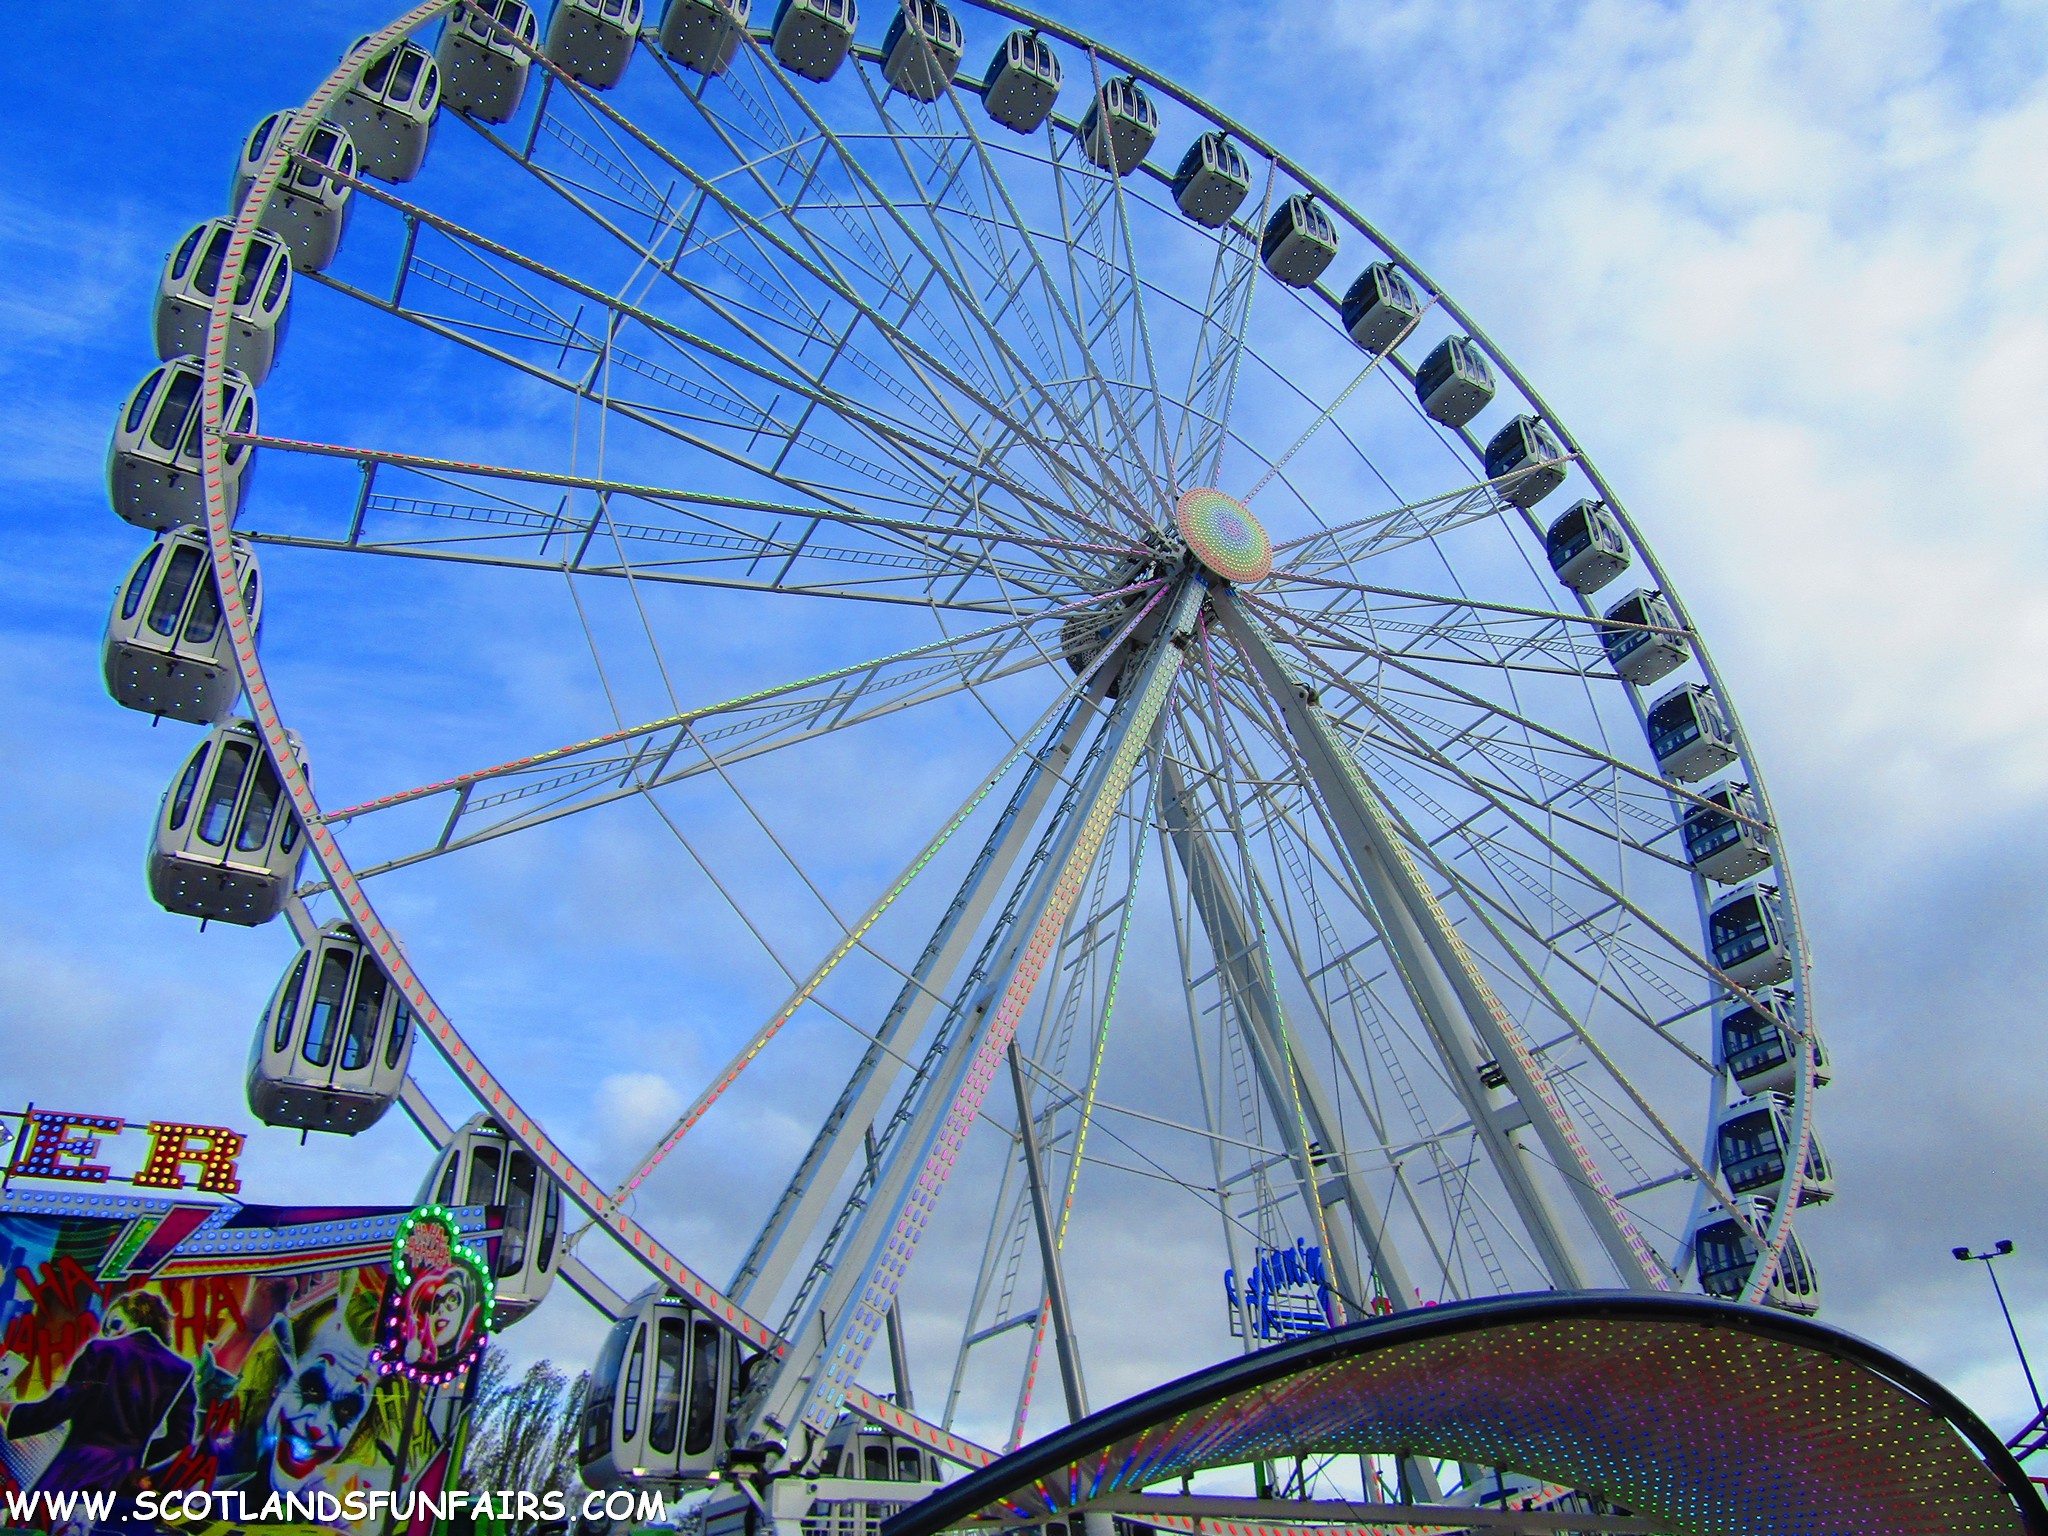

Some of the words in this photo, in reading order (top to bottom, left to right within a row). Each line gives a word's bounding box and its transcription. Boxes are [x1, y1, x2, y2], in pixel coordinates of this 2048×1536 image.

[0, 1109, 243, 1194] ER
[16, 1256, 102, 1316] HA
[172, 1277, 246, 1356] HA
[204, 1395, 240, 1438] HA
[160, 1444, 218, 1495] HA
